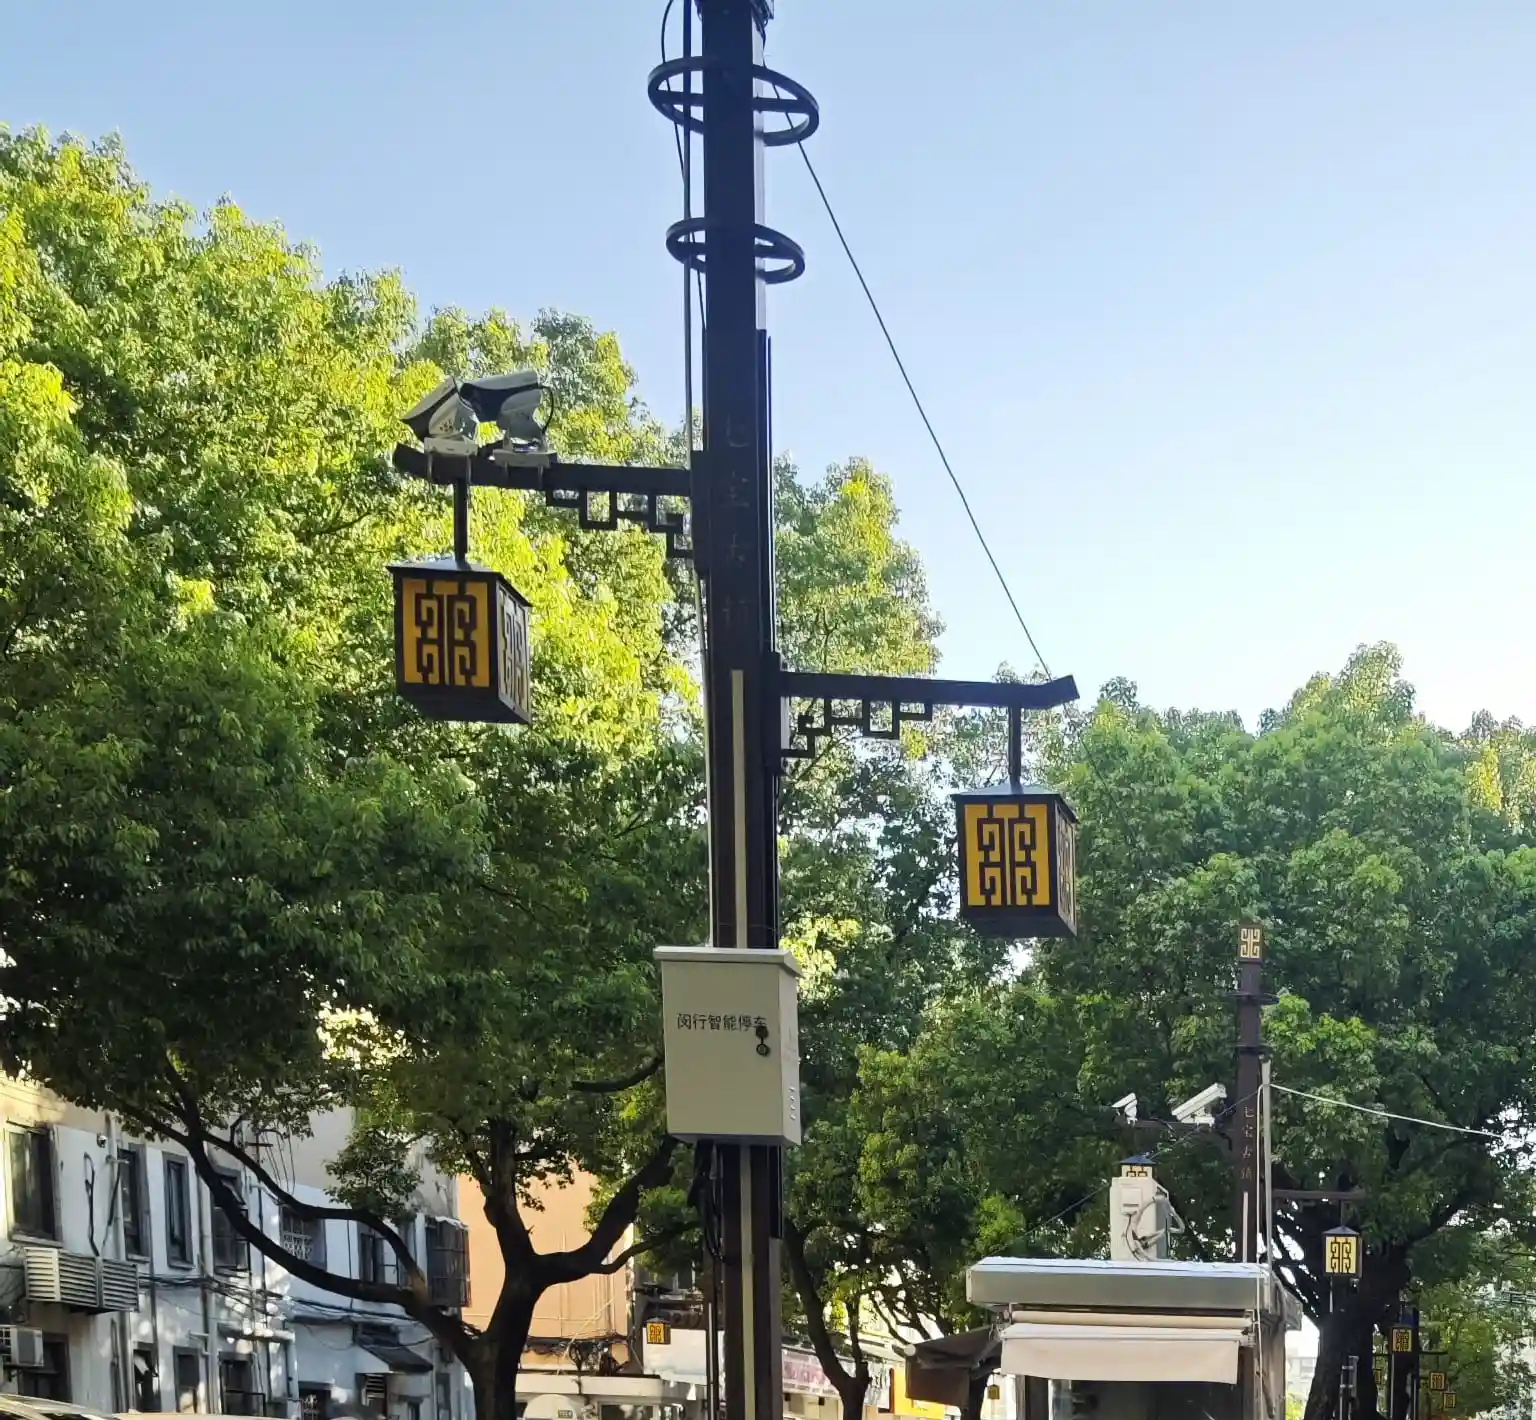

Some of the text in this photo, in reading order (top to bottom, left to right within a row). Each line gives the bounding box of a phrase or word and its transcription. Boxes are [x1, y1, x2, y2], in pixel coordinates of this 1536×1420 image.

[677, 1012, 767, 1032] 闵行智能停车
